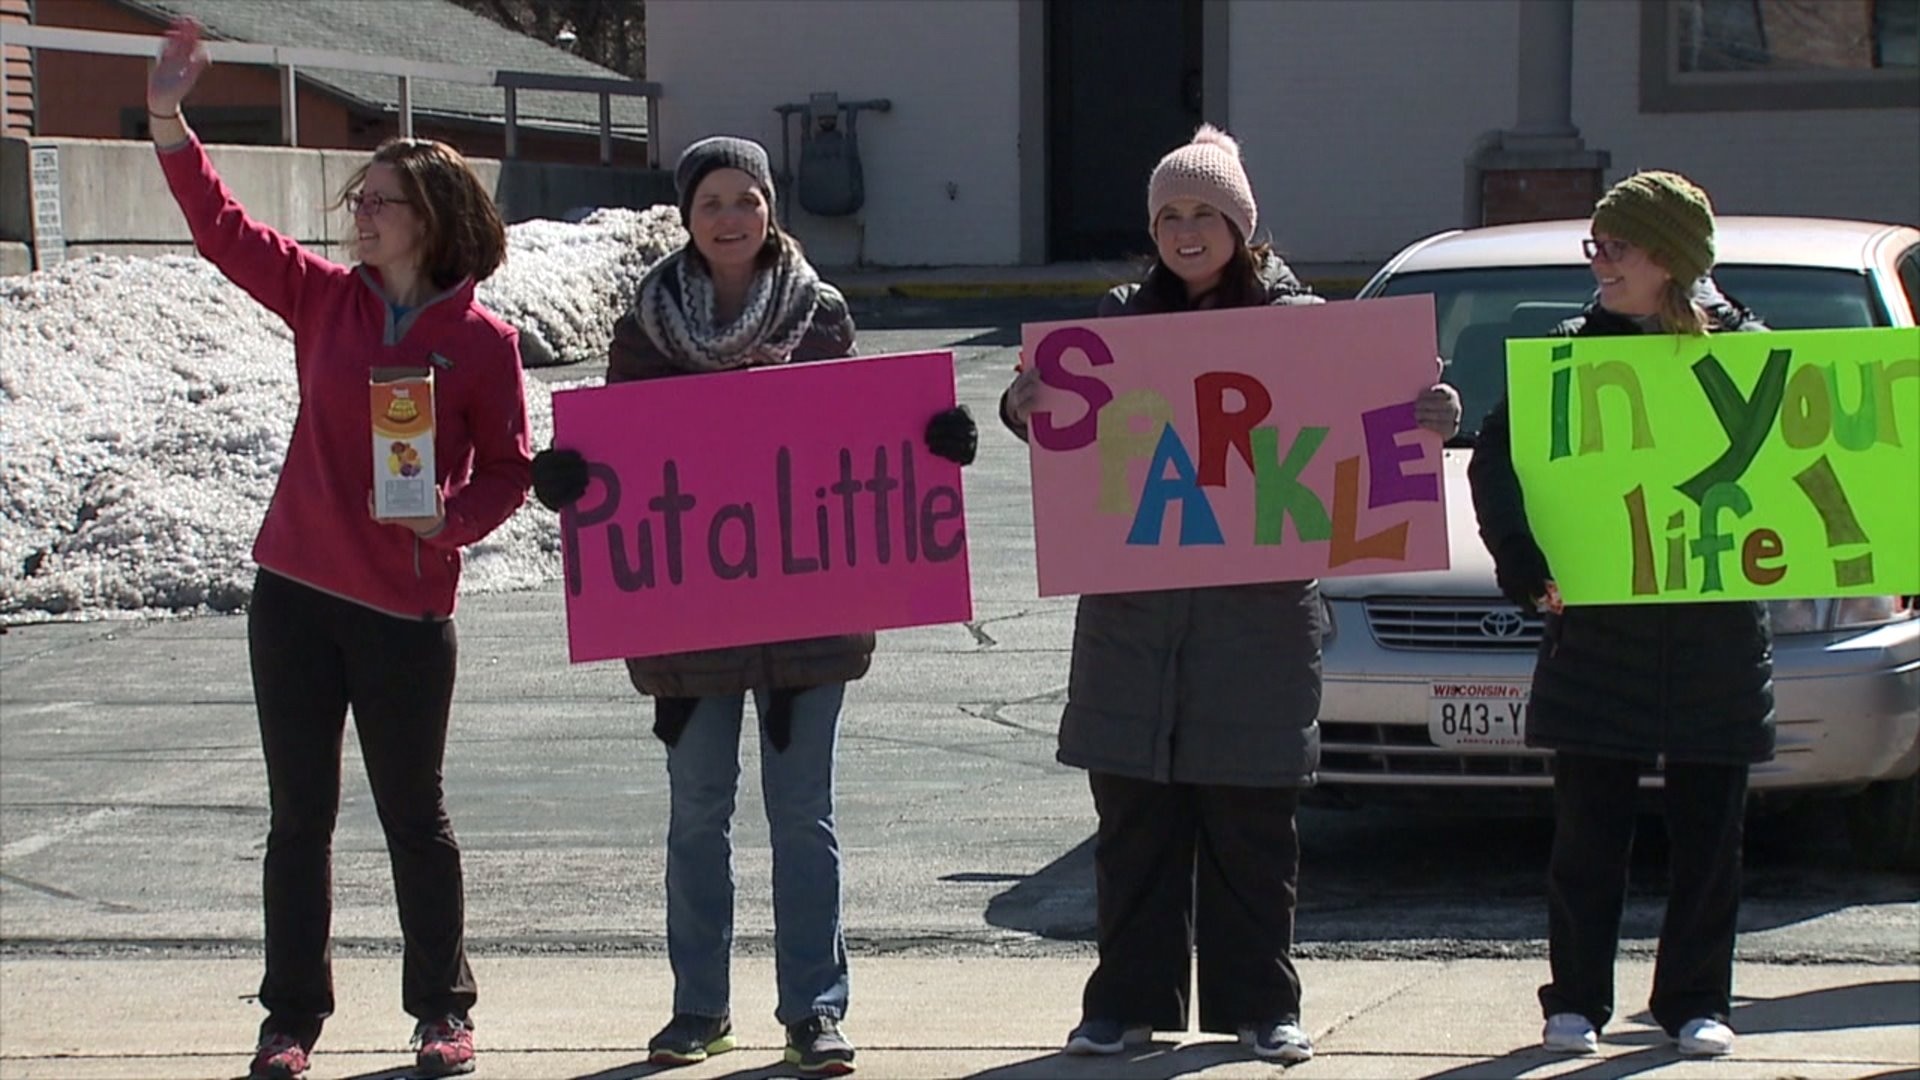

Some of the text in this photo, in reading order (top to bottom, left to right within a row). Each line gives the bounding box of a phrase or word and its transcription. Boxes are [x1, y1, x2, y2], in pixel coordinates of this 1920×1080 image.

[1032, 327, 1440, 569] SPARKLE
[1550, 343, 1920, 506] in your
[562, 440, 966, 597] Put a Little
[1434, 685, 1506, 697] WISCONSIN
[1442, 703, 1522, 735] 843-Y
